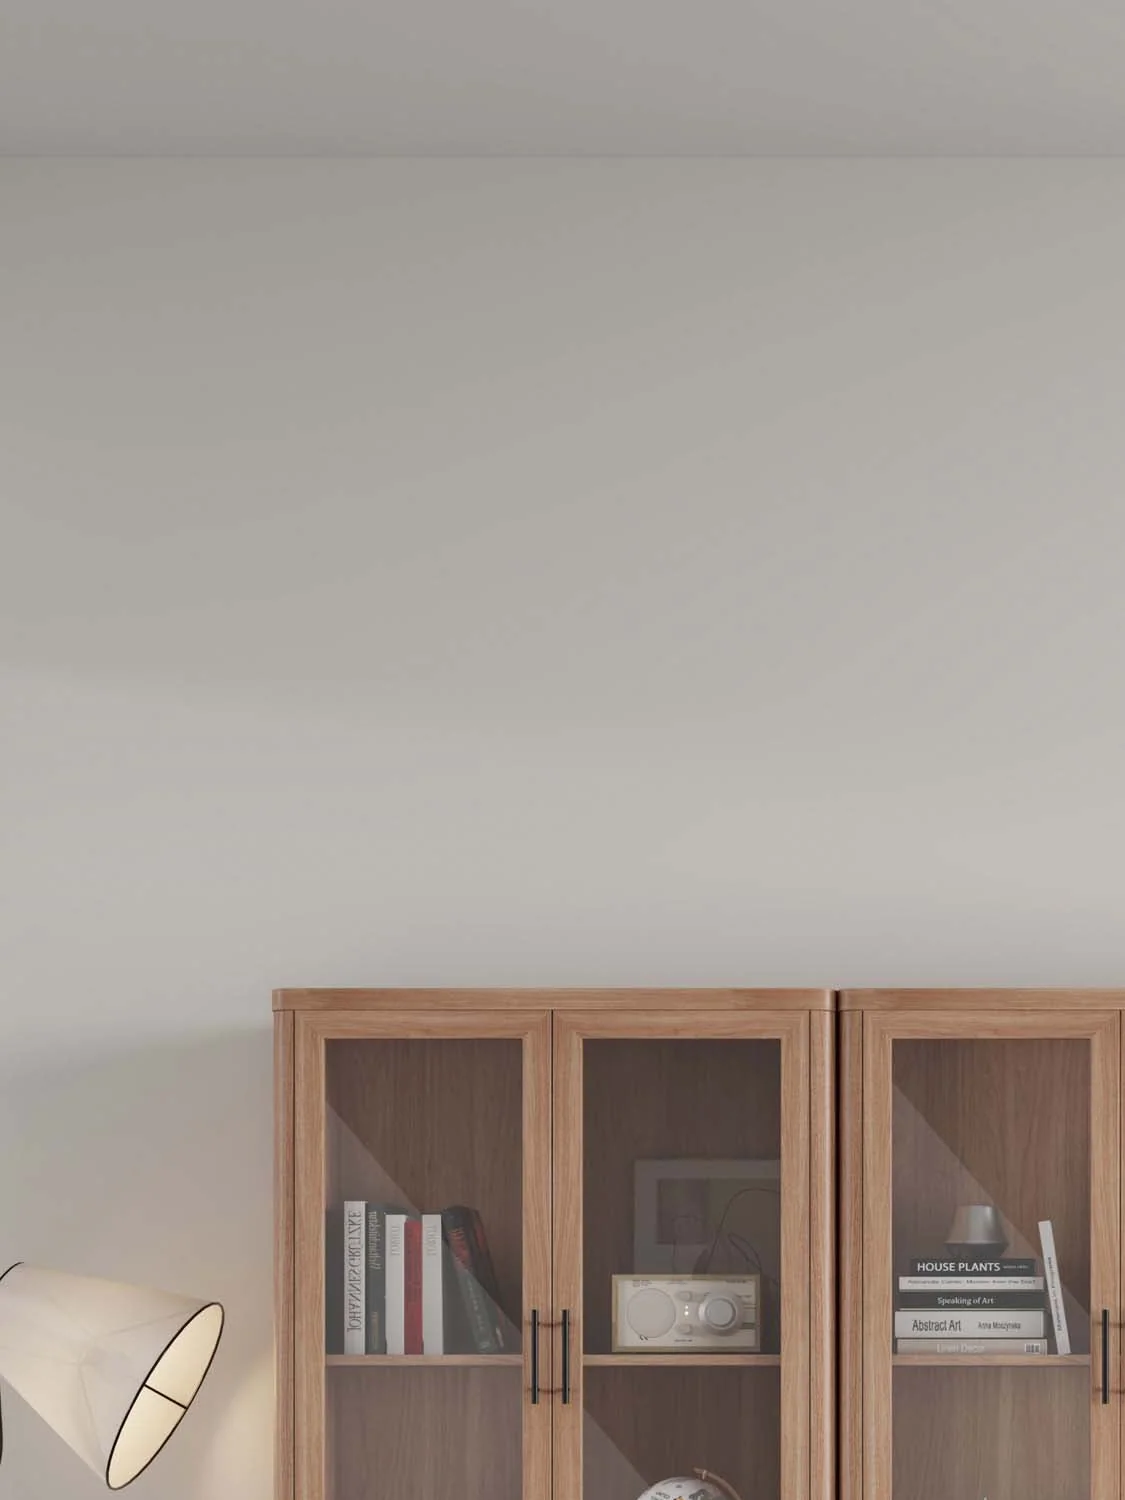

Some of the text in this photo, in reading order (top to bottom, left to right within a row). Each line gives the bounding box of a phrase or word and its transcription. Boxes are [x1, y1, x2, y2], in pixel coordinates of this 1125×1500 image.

[917, 1262, 1000, 1272] HOUSE PLANTS
[937, 1297, 994, 1305] Speaking of Art
[912, 1319, 961, 1332] Abstract Art
